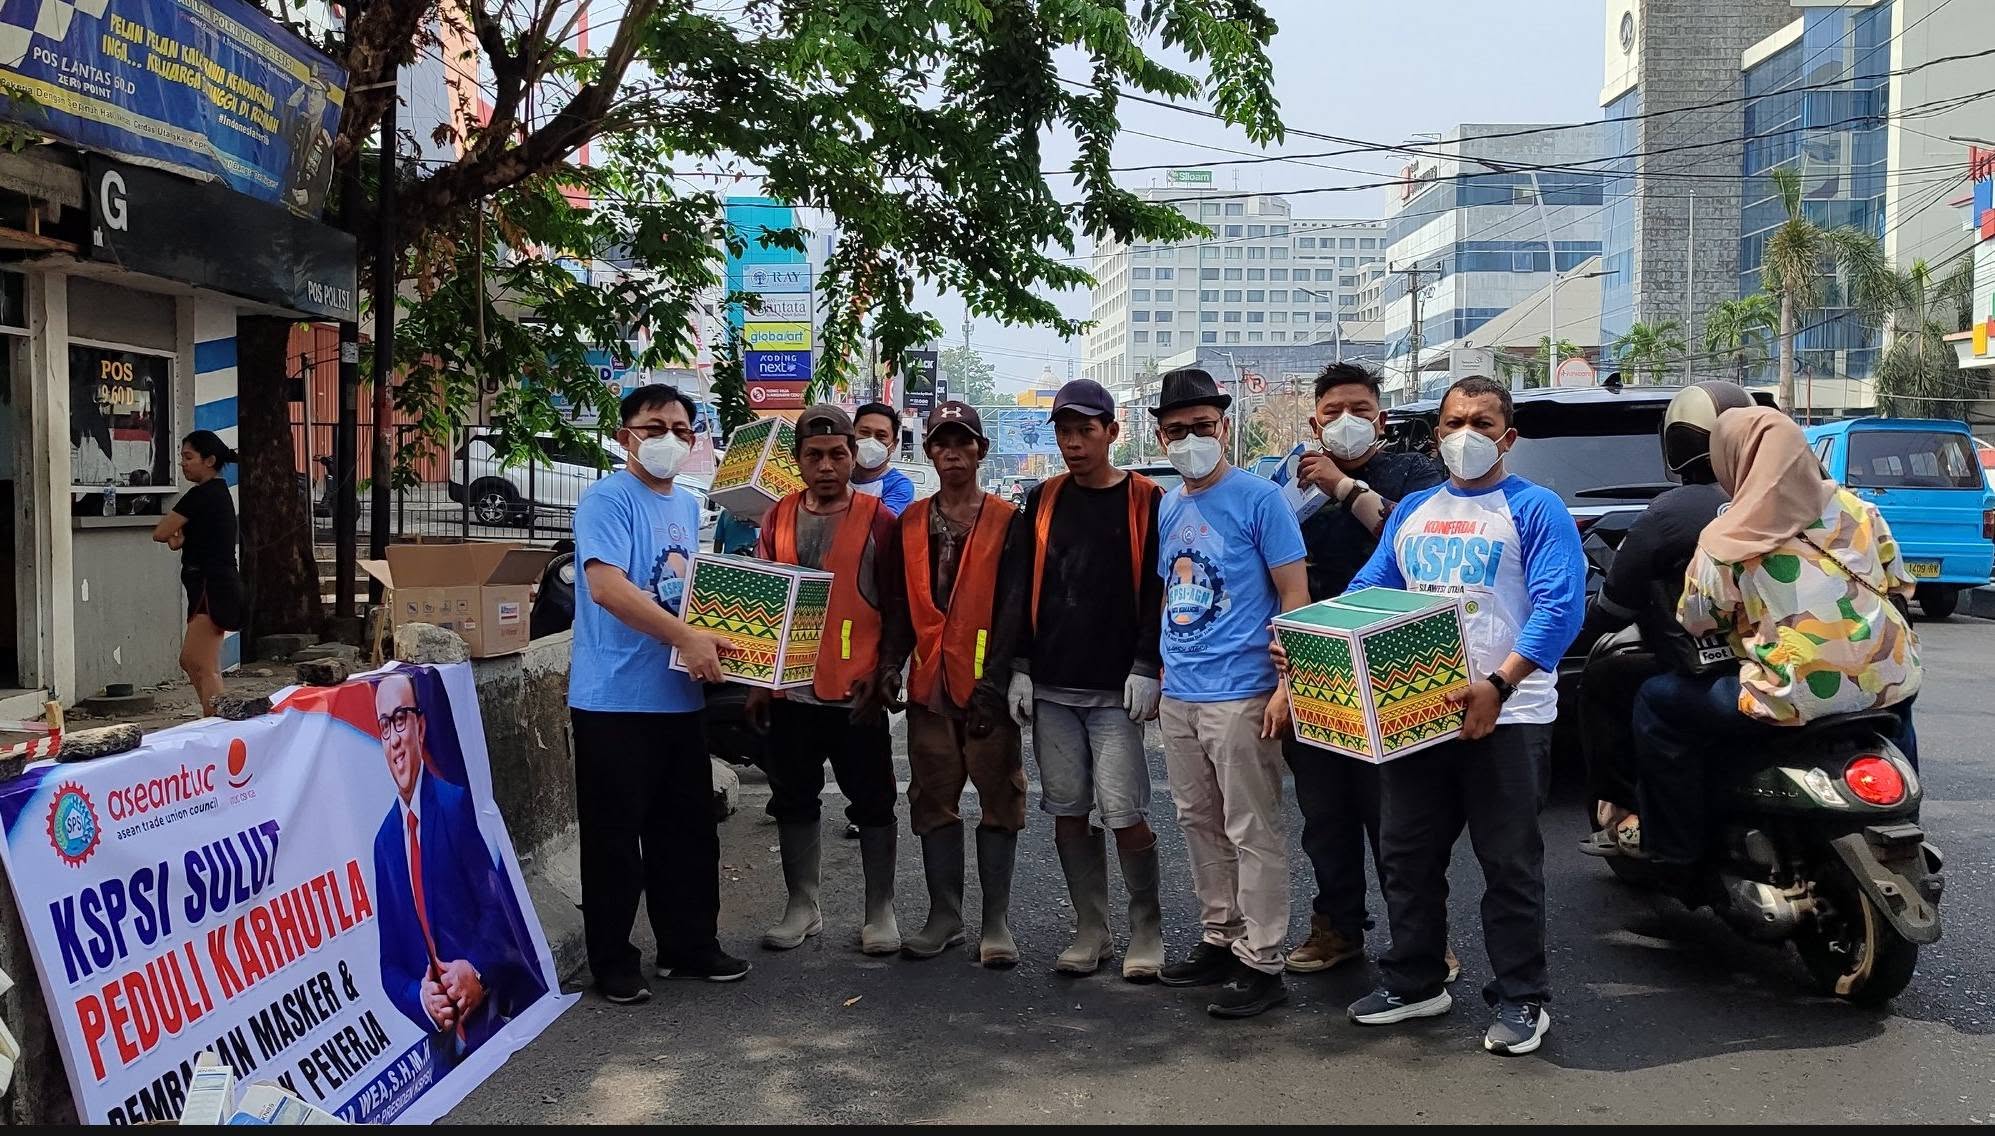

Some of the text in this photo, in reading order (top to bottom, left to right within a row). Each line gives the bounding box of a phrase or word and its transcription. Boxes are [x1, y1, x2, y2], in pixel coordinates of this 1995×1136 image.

[110, 13, 144, 44] PELAN
[146, 29, 179, 58] PELAN
[212, 12, 239, 36] POLRI
[33, 47, 58, 68] POS
[61, 57, 112, 86] LANTAS
[57, 74, 111, 99] ZERO POINT
[146, 52, 201, 90] KELUARGA
[238, 100, 250, 118] DI
[1180, 171, 1210, 181] Siloam
[308, 280, 351, 311] POS POLISI
[773, 271, 801, 282] RAY
[101, 360, 134, 381] POS
[760, 362, 787, 373] next
[1404, 536, 1504, 587] KSPSI
[108, 763, 216, 822] aseantuc
[117, 798, 220, 841] asean trade union council
[49, 819, 281, 985] KSPSI SULUT
[75, 859, 374, 1081] PEDULI KARHUTLA
[107, 959, 360, 1125] PEMBAAN MASKER &
[297, 1009, 392, 1102] PEKERJA
